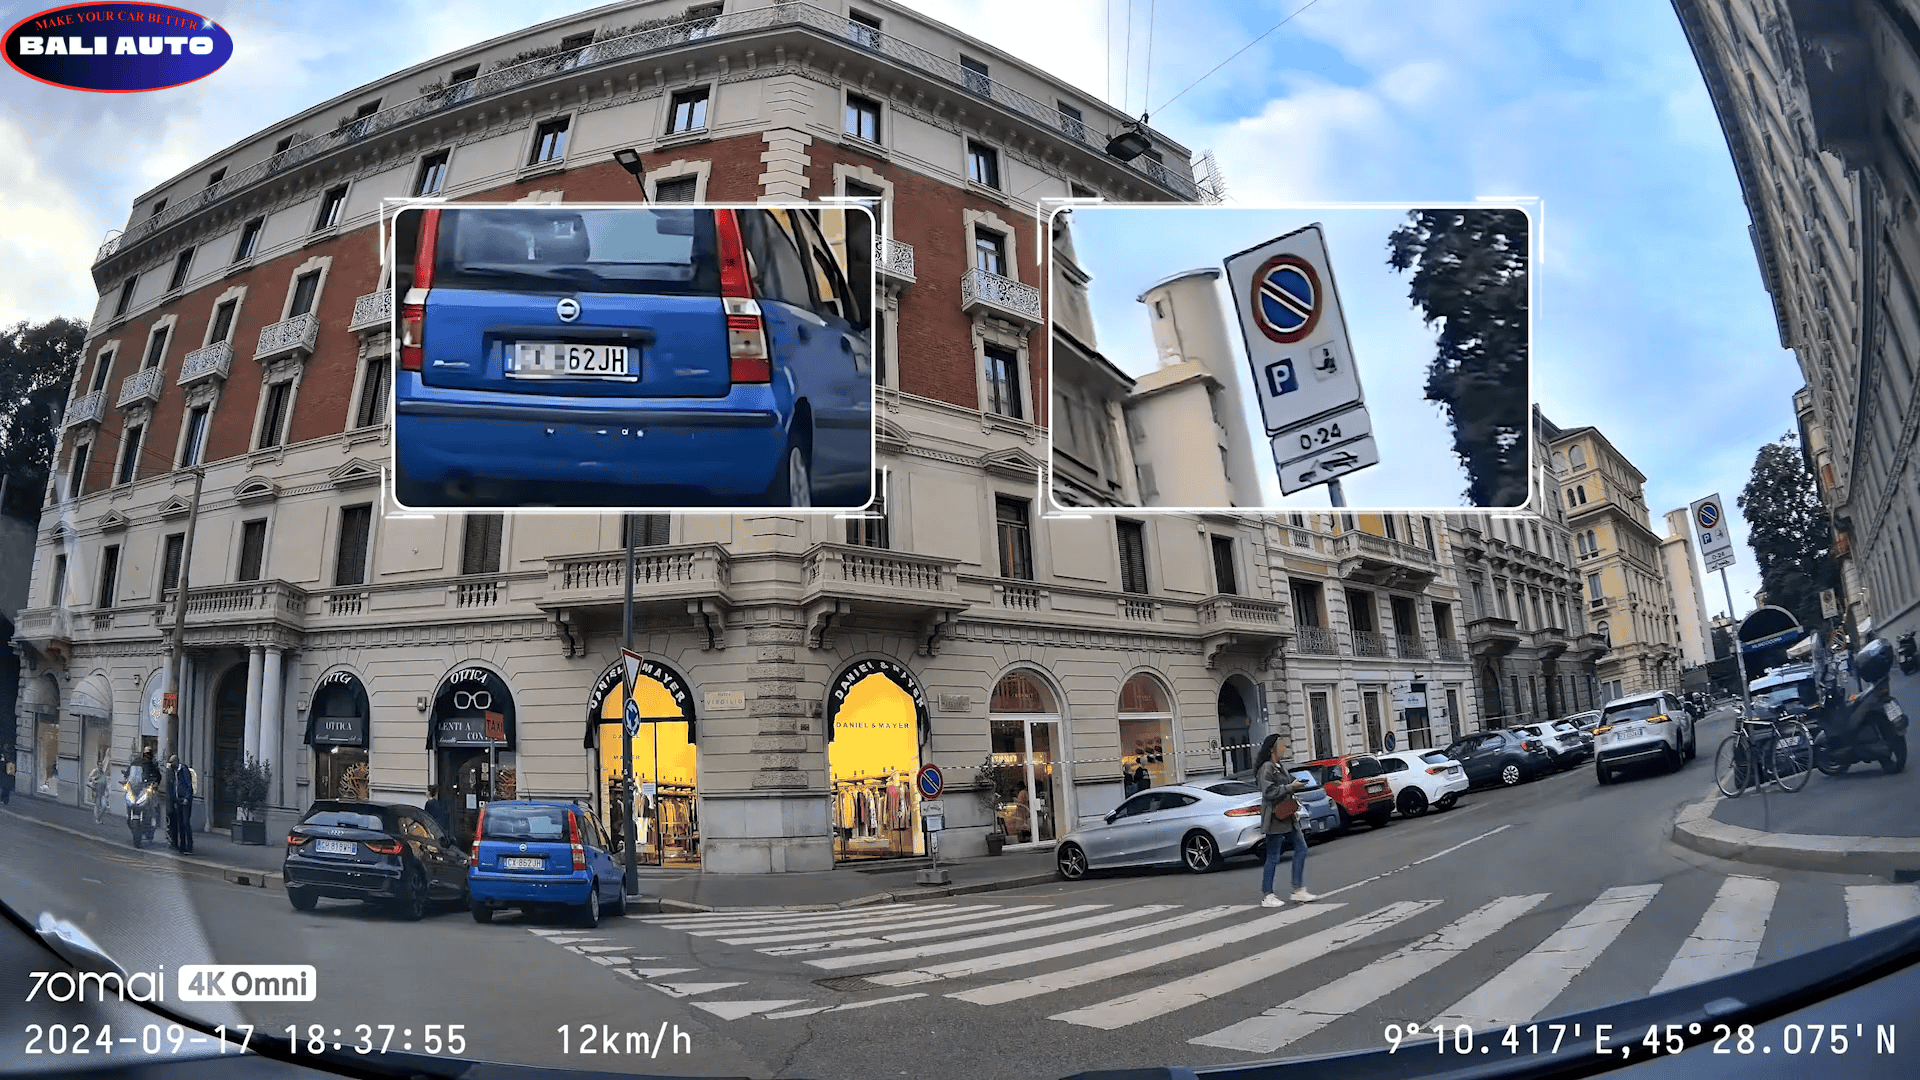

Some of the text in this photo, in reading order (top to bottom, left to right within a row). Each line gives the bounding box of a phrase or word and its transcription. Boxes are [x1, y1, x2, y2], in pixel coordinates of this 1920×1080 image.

[450, 669, 488, 684] OTTICA
[641, 662, 685, 703] MAYER
[834, 661, 875, 700] DANIEL
[880, 661, 889, 670] &
[486, 719, 503, 733] TAXI
[835, 721, 868, 729] DANIEL
[878, 721, 910, 729] MAYER
